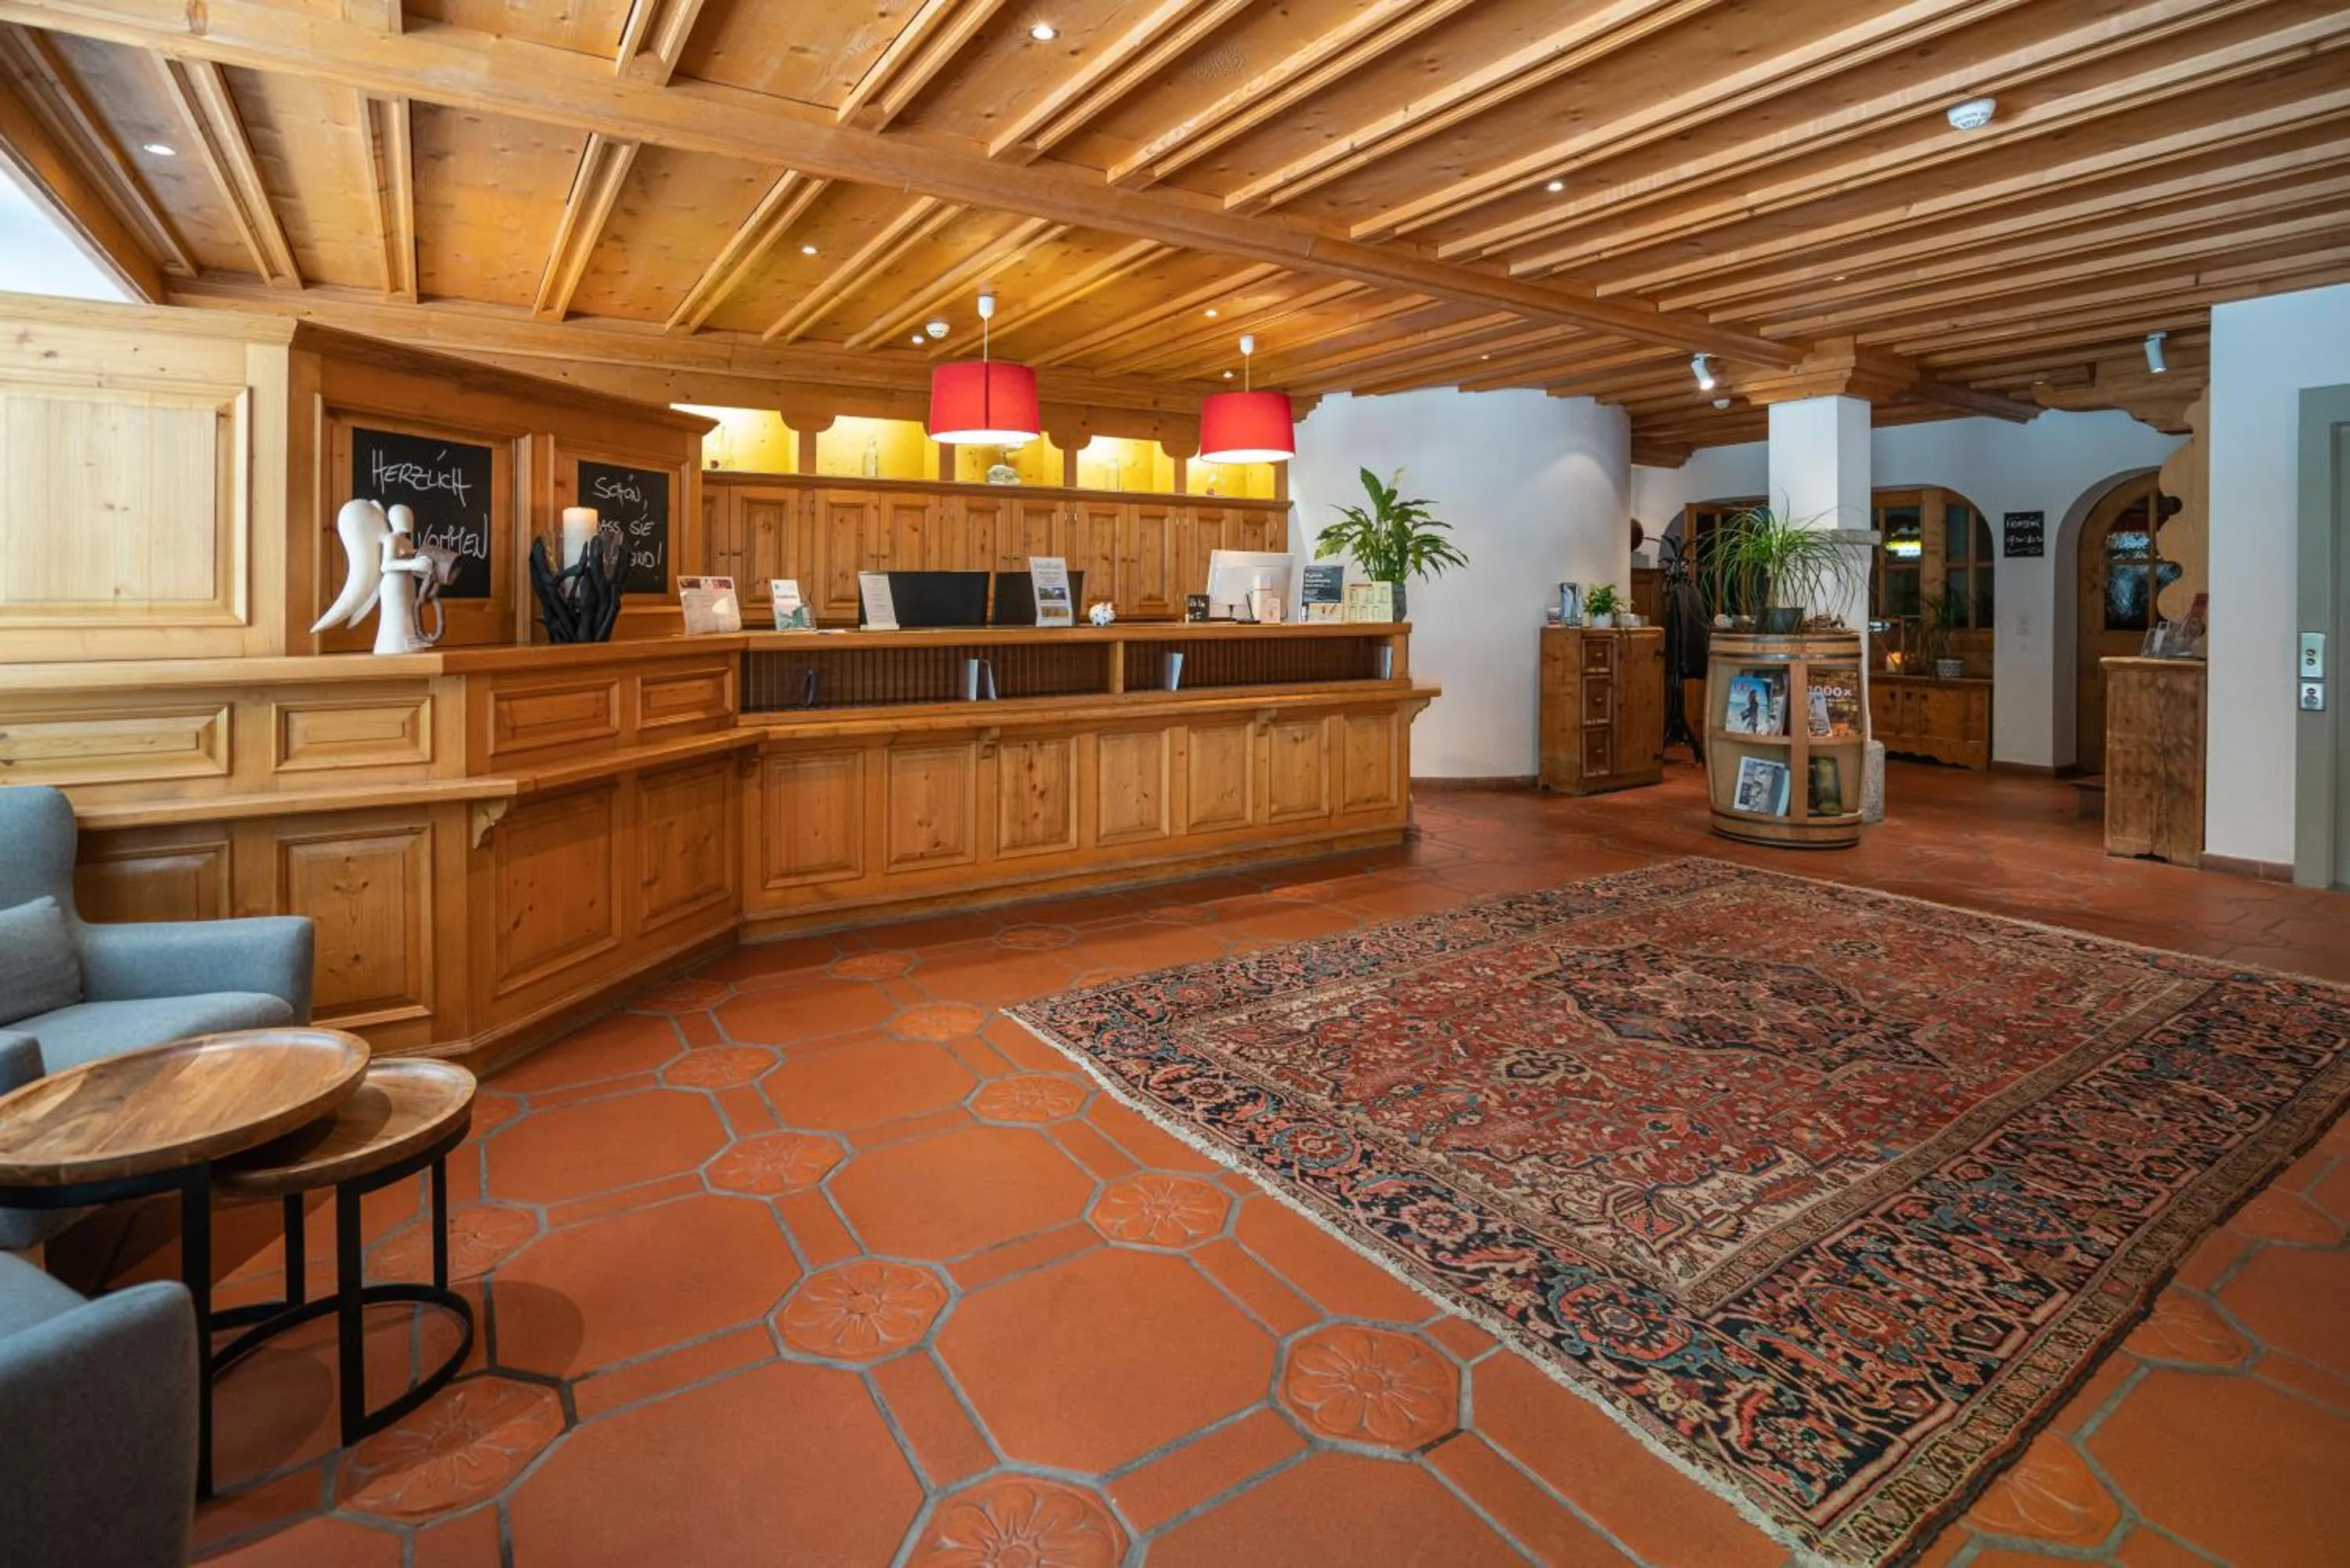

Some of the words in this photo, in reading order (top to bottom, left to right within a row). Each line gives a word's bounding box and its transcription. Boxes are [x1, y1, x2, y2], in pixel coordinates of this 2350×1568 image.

[372, 448, 472, 508] HERZLICH
[601, 518, 621, 533] ASS
[628, 513, 655, 536] SIE
